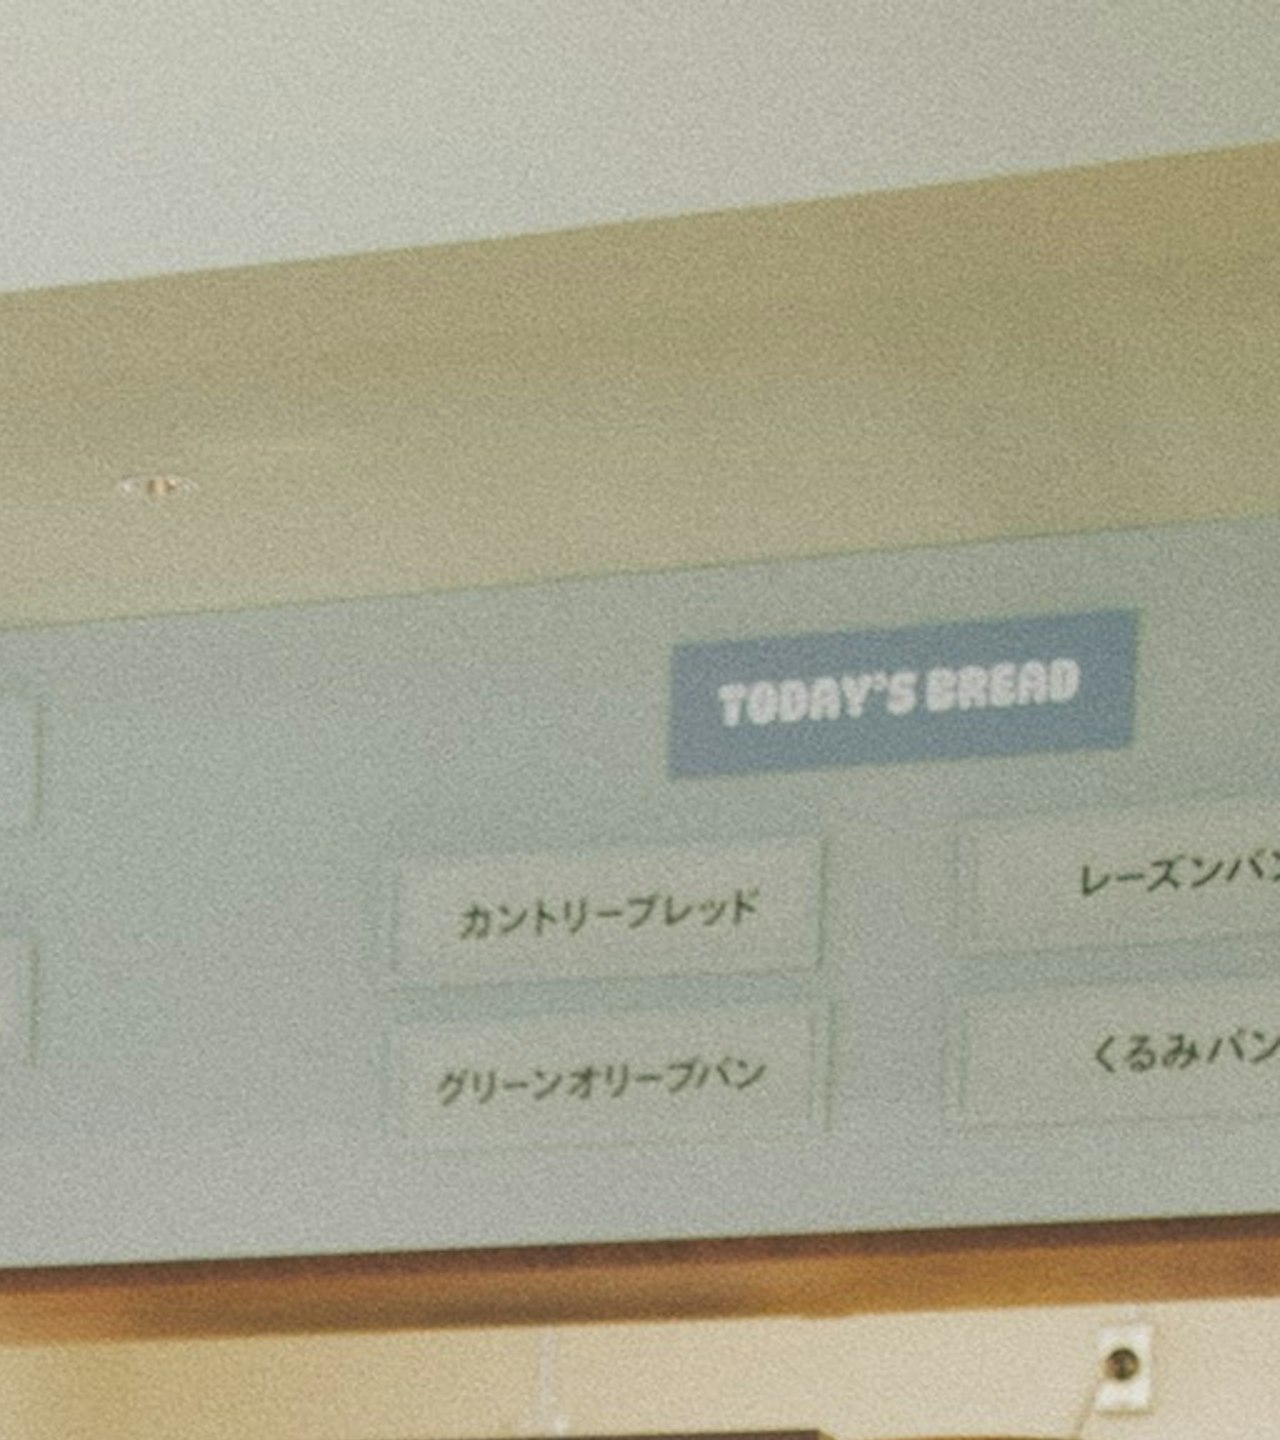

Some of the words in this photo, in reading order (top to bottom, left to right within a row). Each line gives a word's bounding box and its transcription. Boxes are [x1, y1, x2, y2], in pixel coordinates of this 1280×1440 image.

[719, 671, 917, 727] TODAY'S
[925, 657, 1081, 712] BREAD
[460, 888, 760, 940] カントリーブレッド
[1096, 1027, 1280, 1074] くるみパン
[437, 1055, 767, 1107] グリーンオリーブパン
